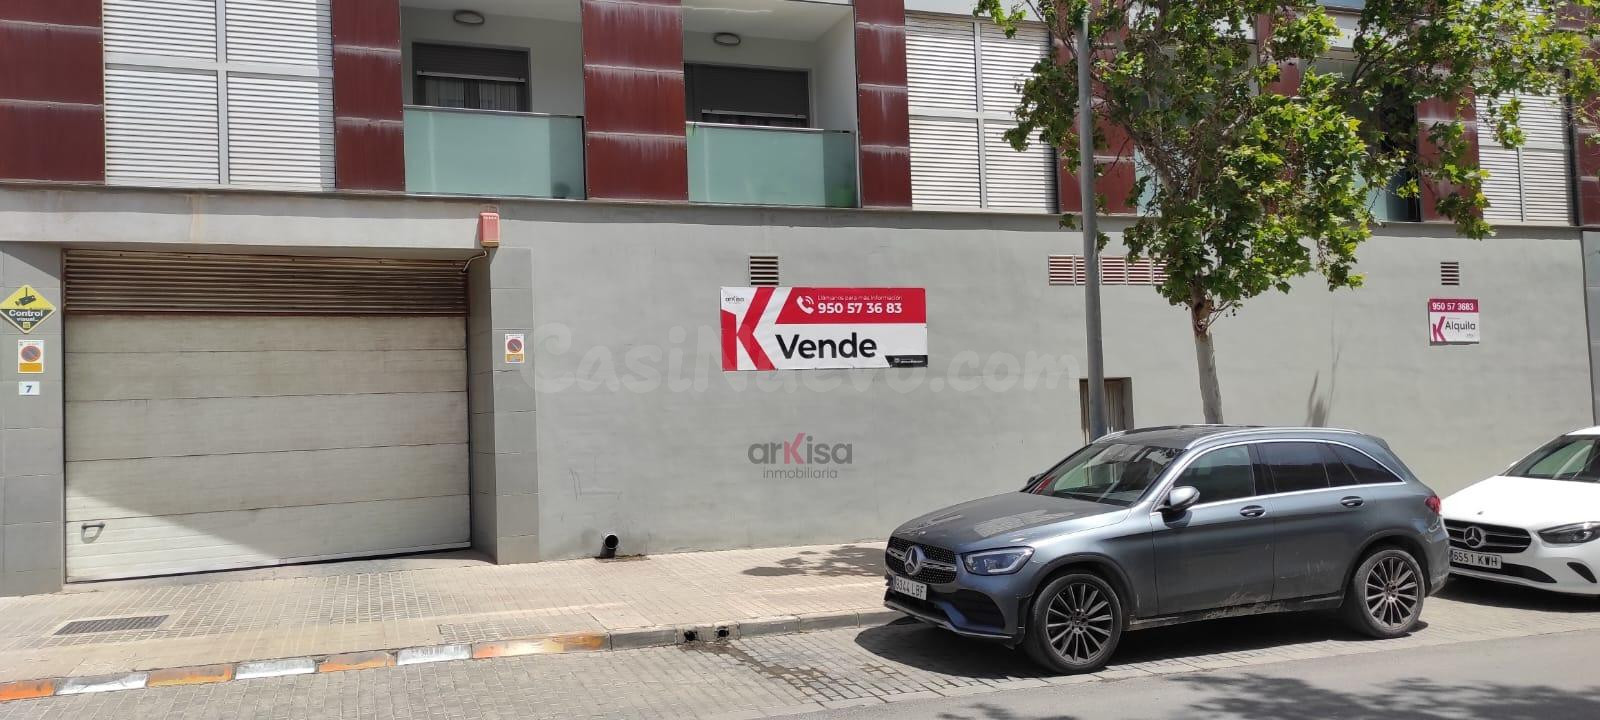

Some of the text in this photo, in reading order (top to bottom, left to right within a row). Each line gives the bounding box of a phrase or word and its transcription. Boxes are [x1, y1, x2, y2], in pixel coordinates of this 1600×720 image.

[818, 303, 902, 314] 950 57 36 83
[1432, 302, 1474, 311] 950 57 3683
[8, 309, 43, 317] Control
[1445, 321, 1476, 332] Alquila
[775, 332, 877, 359] Vende
[26, 385, 32, 393] 7
[1453, 551, 1497, 566] 6551 KWH
